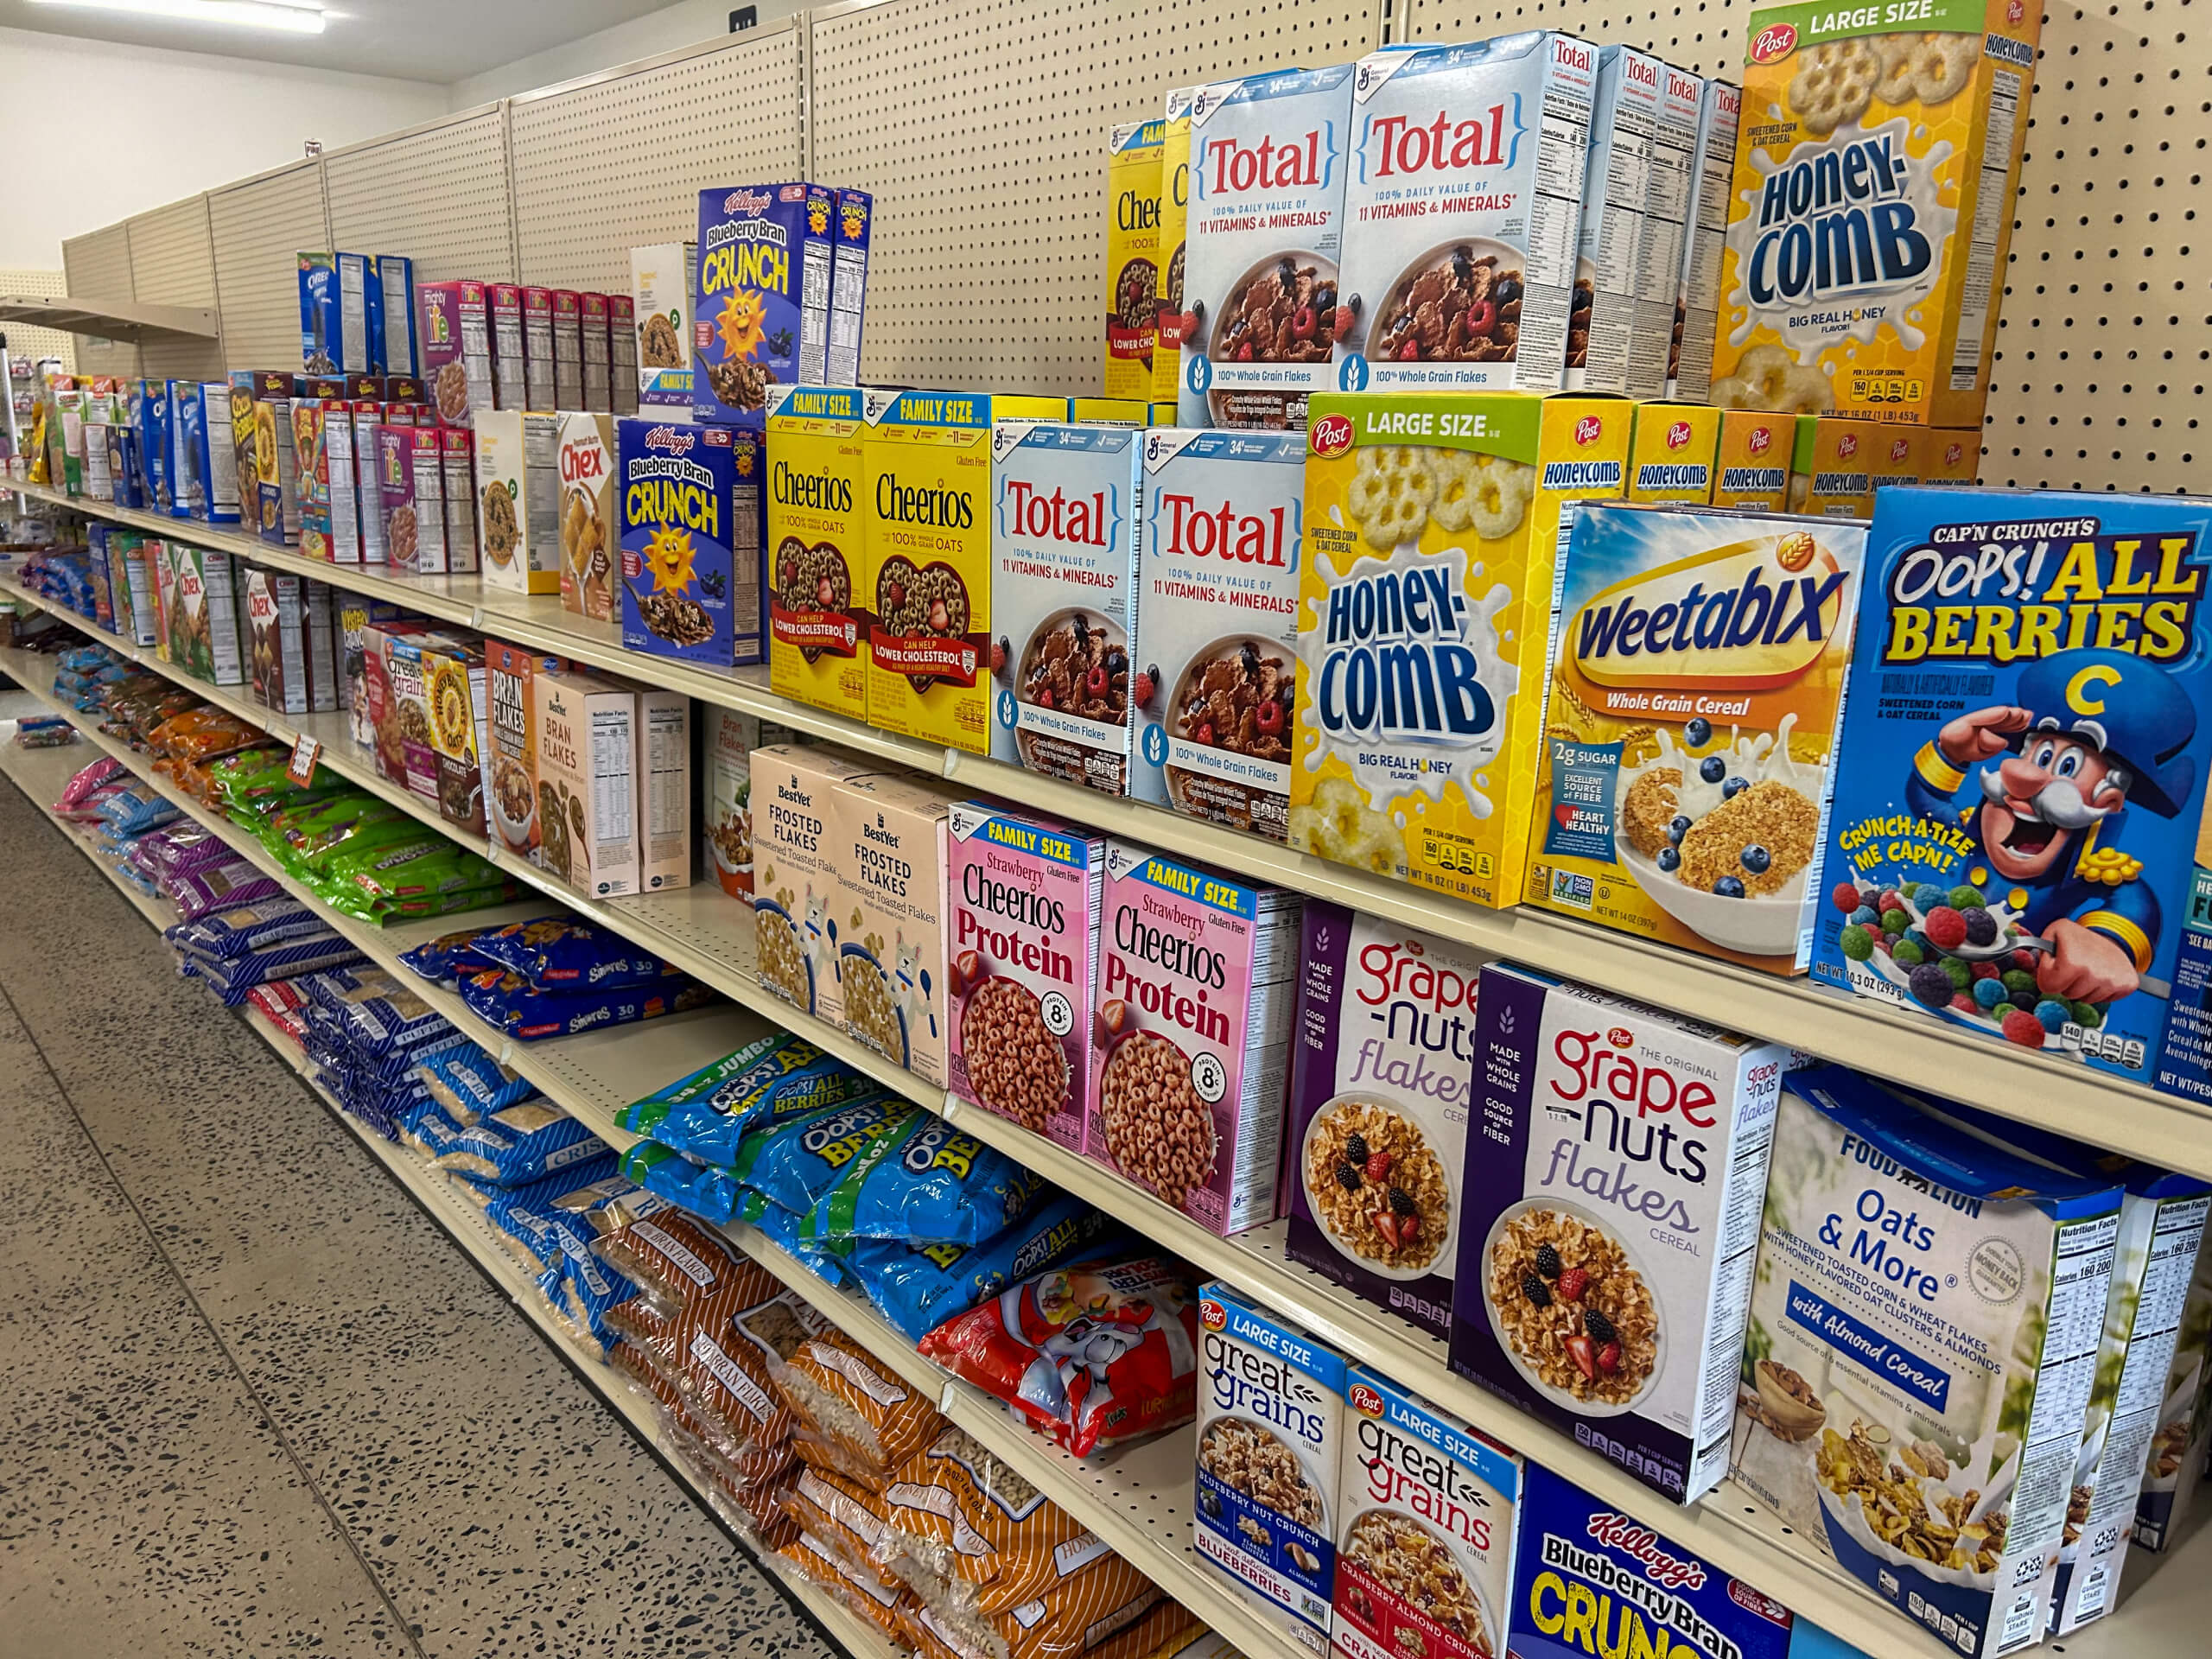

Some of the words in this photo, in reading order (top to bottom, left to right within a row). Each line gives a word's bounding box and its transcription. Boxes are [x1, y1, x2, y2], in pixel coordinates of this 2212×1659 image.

[1810, 7, 1878, 35] LARGE
[1885, 0, 1933, 23] SIZE
[1371, 104, 1504, 177] Total
[1209, 130, 1320, 194] Total
[724, 188, 772, 216] Kellogg's
[709, 221, 759, 246] Blueberry
[760, 220, 785, 244] Bran
[702, 243, 789, 296] CRUNCH
[1789, 314, 1808, 328] BIG
[1810, 312, 1840, 326] REAL
[1844, 307, 1886, 323] HONEY
[659, 372, 683, 391] FAMILY
[793, 394, 827, 414] FAMILY
[829, 395, 851, 416] SIZE
[900, 399, 942, 421] FAMILY
[945, 400, 972, 423] SIZE
[1367, 412, 1431, 436] LARGE
[1439, 414, 1486, 437] SIZE
[1577, 420, 1601, 442] Post
[645, 426, 694, 455] Kellogg's
[561, 445, 602, 480] Chex
[630, 457, 683, 480] Blueberry
[683, 461, 713, 486] Bran
[774, 461, 853, 512] Cheerios
[876, 474, 972, 529] Cheerios
[626, 480, 718, 536] CRUNCH
[1007, 480, 1106, 546] Total
[1311, 527, 1343, 541] SWEETENED
[1344, 530, 1357, 542] CORN
[1934, 524, 1987, 543] CAP'N
[1993, 518, 2094, 541] CRUNCH'S
[1154, 580, 1161, 594] 11
[1164, 581, 1215, 603] VITAMINS
[1217, 590, 1226, 603] &
[1168, 568, 1192, 581] 100%
[1197, 572, 1222, 584] DAILY
[1226, 576, 1255, 589] VALUE
[1261, 581, 1272, 591] OF
[1577, 565, 1851, 660] Weetabix
[1886, 601, 2188, 661] BERRIES
[389, 659, 418, 680] great
[875, 644, 901, 661] LOWER
[902, 651, 960, 665] CHOLESTEROL
[493, 670, 523, 709] BRAN
[1606, 693, 1649, 710] Whole
[1652, 695, 1692, 714] Grain
[1695, 697, 1751, 715] Cereal
[493, 700, 524, 734] FLAKES
[546, 718, 571, 745] BRAN
[543, 737, 576, 769] FLAKES
[1175, 747, 1194, 760] 100%
[1196, 751, 1221, 767] Whole
[1224, 757, 1246, 776] Grain
[1247, 764, 1278, 782] Flakes
[1359, 752, 1377, 766] BIG
[1379, 754, 1408, 769] REAL
[1409, 756, 1452, 774] HONEY
[1564, 774, 1603, 786] EXCELLENT
[1564, 782, 1602, 794] SOURCE
[769, 804, 822, 836] FROSTED
[1566, 819, 1610, 836] HEALTHY
[1572, 810, 1605, 823] HEART
[753, 835, 786, 859] Sweetened
[788, 847, 817, 866] Toasted
[863, 823, 899, 849] BestYet
[987, 852, 1045, 887] Strawberry
[1047, 866, 1065, 879] Gluten
[1066, 871, 1080, 883] Free
[963, 863, 1065, 934] Cheerios
[1142, 894, 1205, 934] Strawberry
[957, 907, 1073, 984] Protein
[1815, 961, 1830, 976] NET
[1832, 965, 1844, 977] WT
[1846, 969, 1862, 985] 10.3
[1864, 976, 1875, 988] OZ
[1877, 978, 1895, 996] (293
[1897, 987, 1904, 1001] g)
[1106, 952, 1230, 1046] Protein
[716, 1036, 774, 1078] JUMBO
[1490, 1042, 1521, 1063] MADE
[1640, 1046, 1662, 1063] THE
[1664, 1055, 1719, 1082] ORIGINAL
[1485, 1061, 1521, 1083] WHOLE
[1486, 1073, 1517, 1093] GRAINS
[1550, 1030, 1717, 1128] grape
[1484, 1110, 1513, 1128] SOURCE
[1485, 1097, 1513, 1116] GOOD
[1483, 1126, 1510, 1146] FIBER
[553, 1141, 605, 1166] CRIS
[1856, 1189, 1936, 1251] Oats
[2061, 1224, 2096, 1237] Nutrition
[2098, 1217, 2117, 1231] Facts
[651, 1230, 677, 1253] BRAN
[676, 1248, 711, 1282] FLAKES
[1975, 1253, 2000, 1278] MONEY
[2000, 1270, 2018, 1290] BACK
[2055, 1272, 2077, 1283] Calories
[2080, 1264, 2094, 1277] 160
[2096, 1261, 2111, 1273] 200
[1200, 1303, 1224, 1324] Post
[1764, 1230, 1786, 1252] WITH
[1786, 1243, 1815, 1268] HONEY
[1816, 1262, 1861, 1295] FLAVORED
[1863, 1291, 1882, 1308] OAT
[1885, 1304, 1933, 1338] CLUSTERS
[1935, 1333, 1942, 1344] &
[1944, 1338, 2001, 1375] ALMONDS
[1792, 1295, 1821, 1325] with
[1825, 1316, 1886, 1363] Almond
[1887, 1352, 1941, 1397] Cereal
[1204, 1332, 1295, 1401] great
[1777, 1320, 1796, 1338] Good
[1796, 1333, 1819, 1350] source
[1820, 1349, 1828, 1359] of
[1828, 1355, 1834, 1363] 6
[1835, 1360, 1869, 1387] essential
[1871, 1382, 1904, 1408] vitamins
[1905, 1403, 1911, 1413] &
[1914, 1409, 1951, 1437] minerals
[1211, 1369, 1324, 1443] grains
[1302, 1439, 1321, 1456] CEREAL
[1357, 1419, 1460, 1501] great
[1198, 1471, 1249, 1508] BLUEBERRY
[1252, 1504, 1274, 1522] NUT
[1275, 1518, 1319, 1548] CRUNCH
[1367, 1459, 1491, 1552] grains
[1198, 1533, 1291, 1603] BLUEBERRIES
[1341, 1559, 1395, 1604] CRANBERRY
[1396, 1592, 1441, 1638] ALMOND
[2006, 1610, 2034, 1625] GUIDING
[2007, 1619, 2028, 1632] STARS
